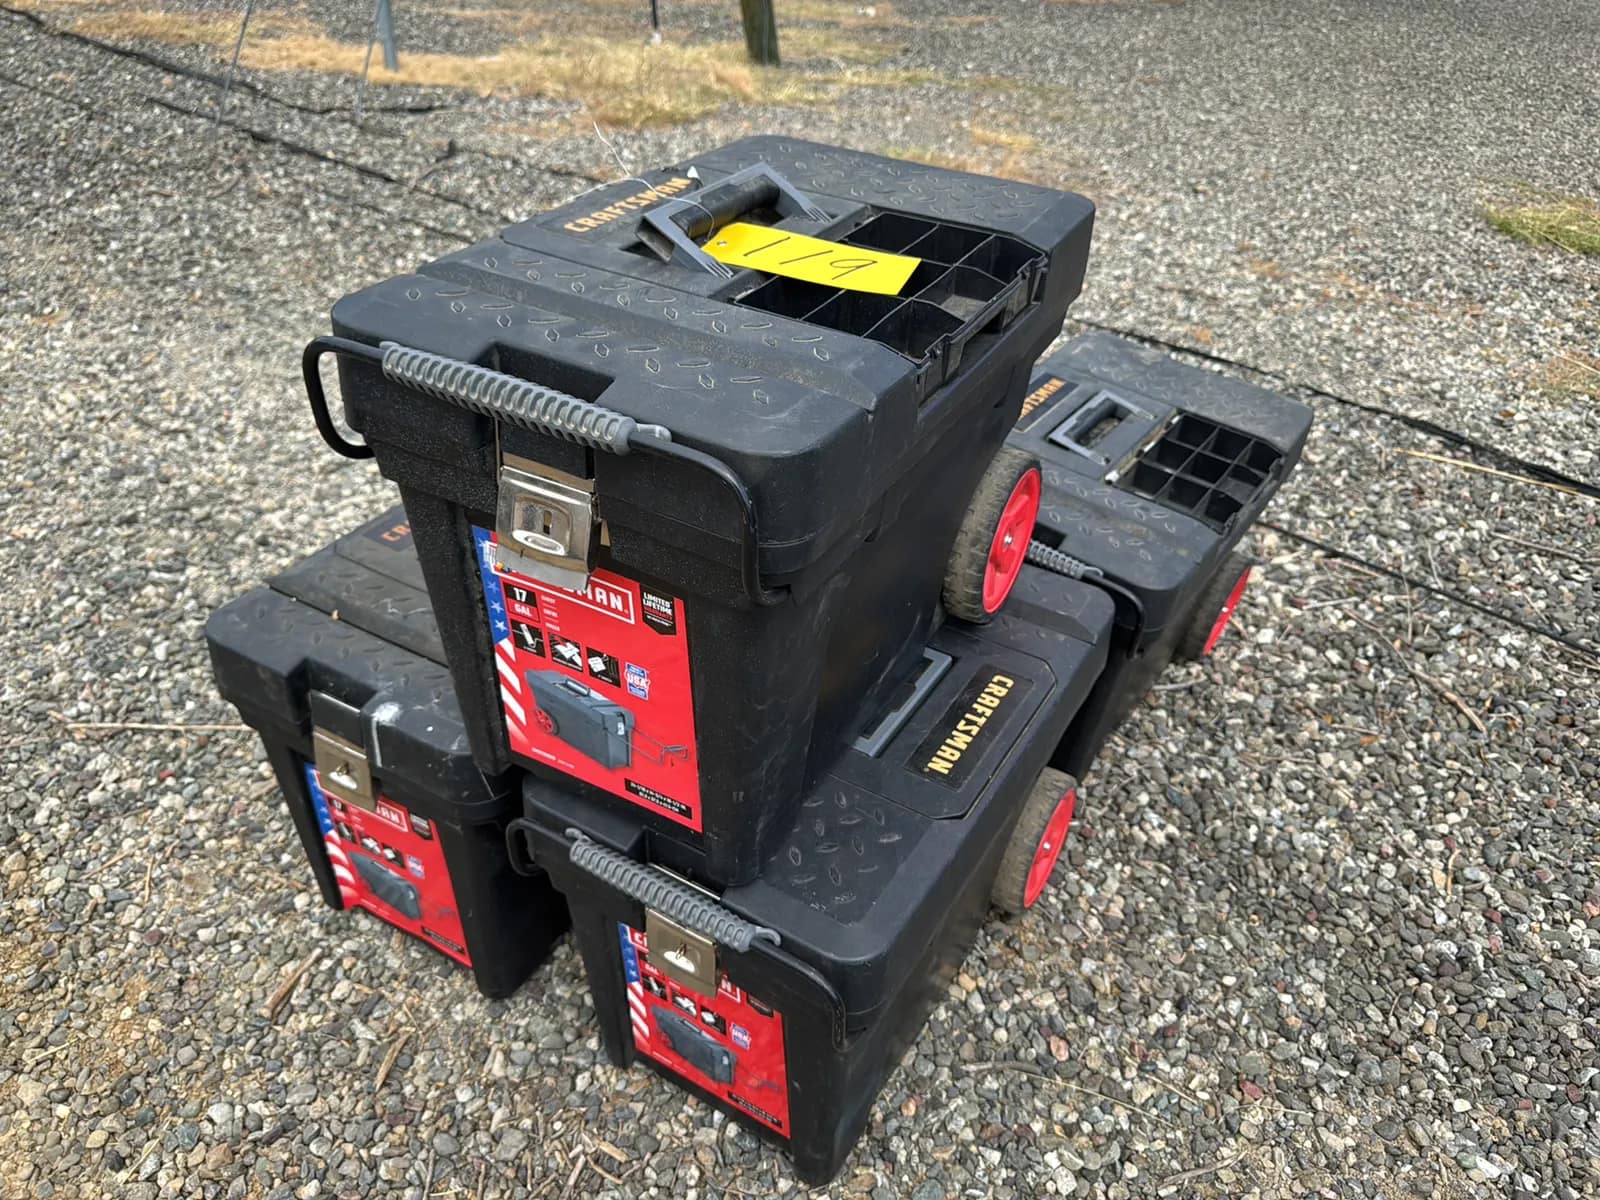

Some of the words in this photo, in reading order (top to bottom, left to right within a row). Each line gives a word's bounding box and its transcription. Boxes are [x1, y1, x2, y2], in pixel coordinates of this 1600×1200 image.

[564, 177, 692, 233] CRAFTSMAN
[513, 586, 527, 602] 17
[643, 591, 671, 608] LIMITED
[514, 603, 533, 617] GAL
[642, 598, 673, 616] LIFETIME
[928, 674, 1015, 775] CRAFTSMAN
